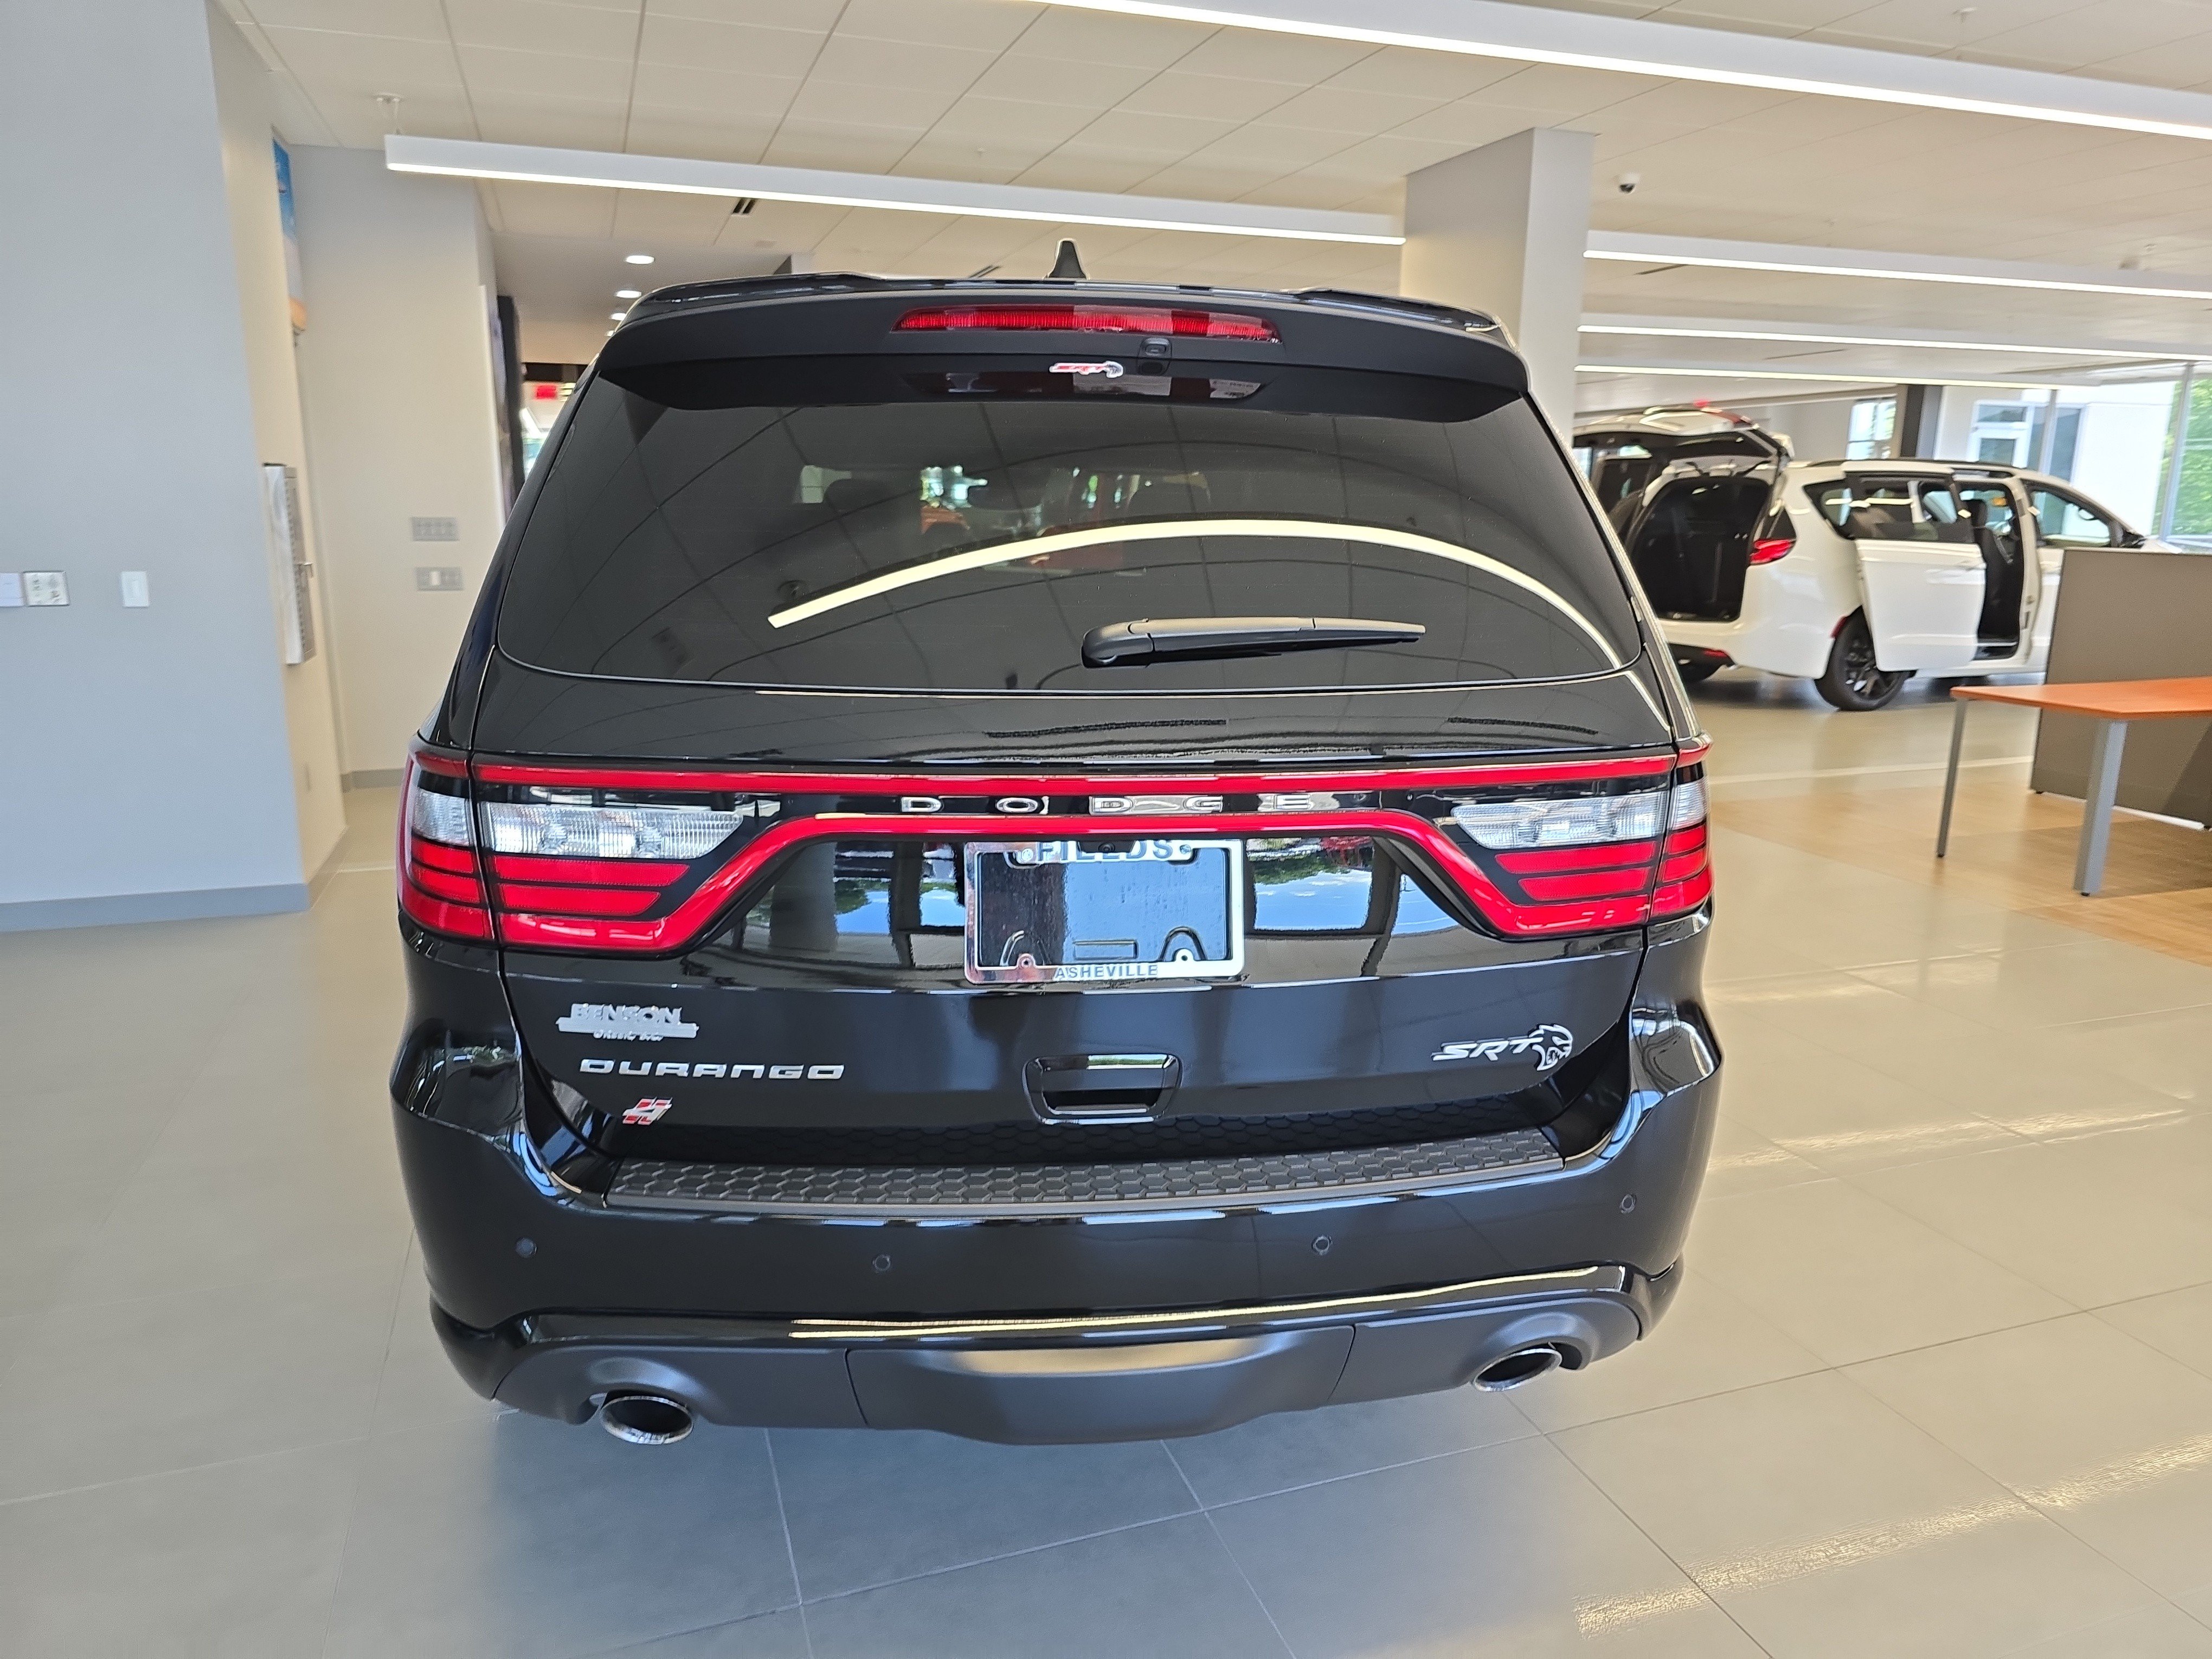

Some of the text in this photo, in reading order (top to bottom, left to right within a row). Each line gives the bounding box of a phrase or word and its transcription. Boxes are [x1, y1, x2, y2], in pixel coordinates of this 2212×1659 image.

[901, 794, 1312, 813] DODGE
[1055, 964, 1158, 979] ASHEVILLE
[571, 1003, 681, 1024] BENSON
[1431, 1036, 1544, 1060] SRT
[580, 1059, 845, 1079] DURANGO
